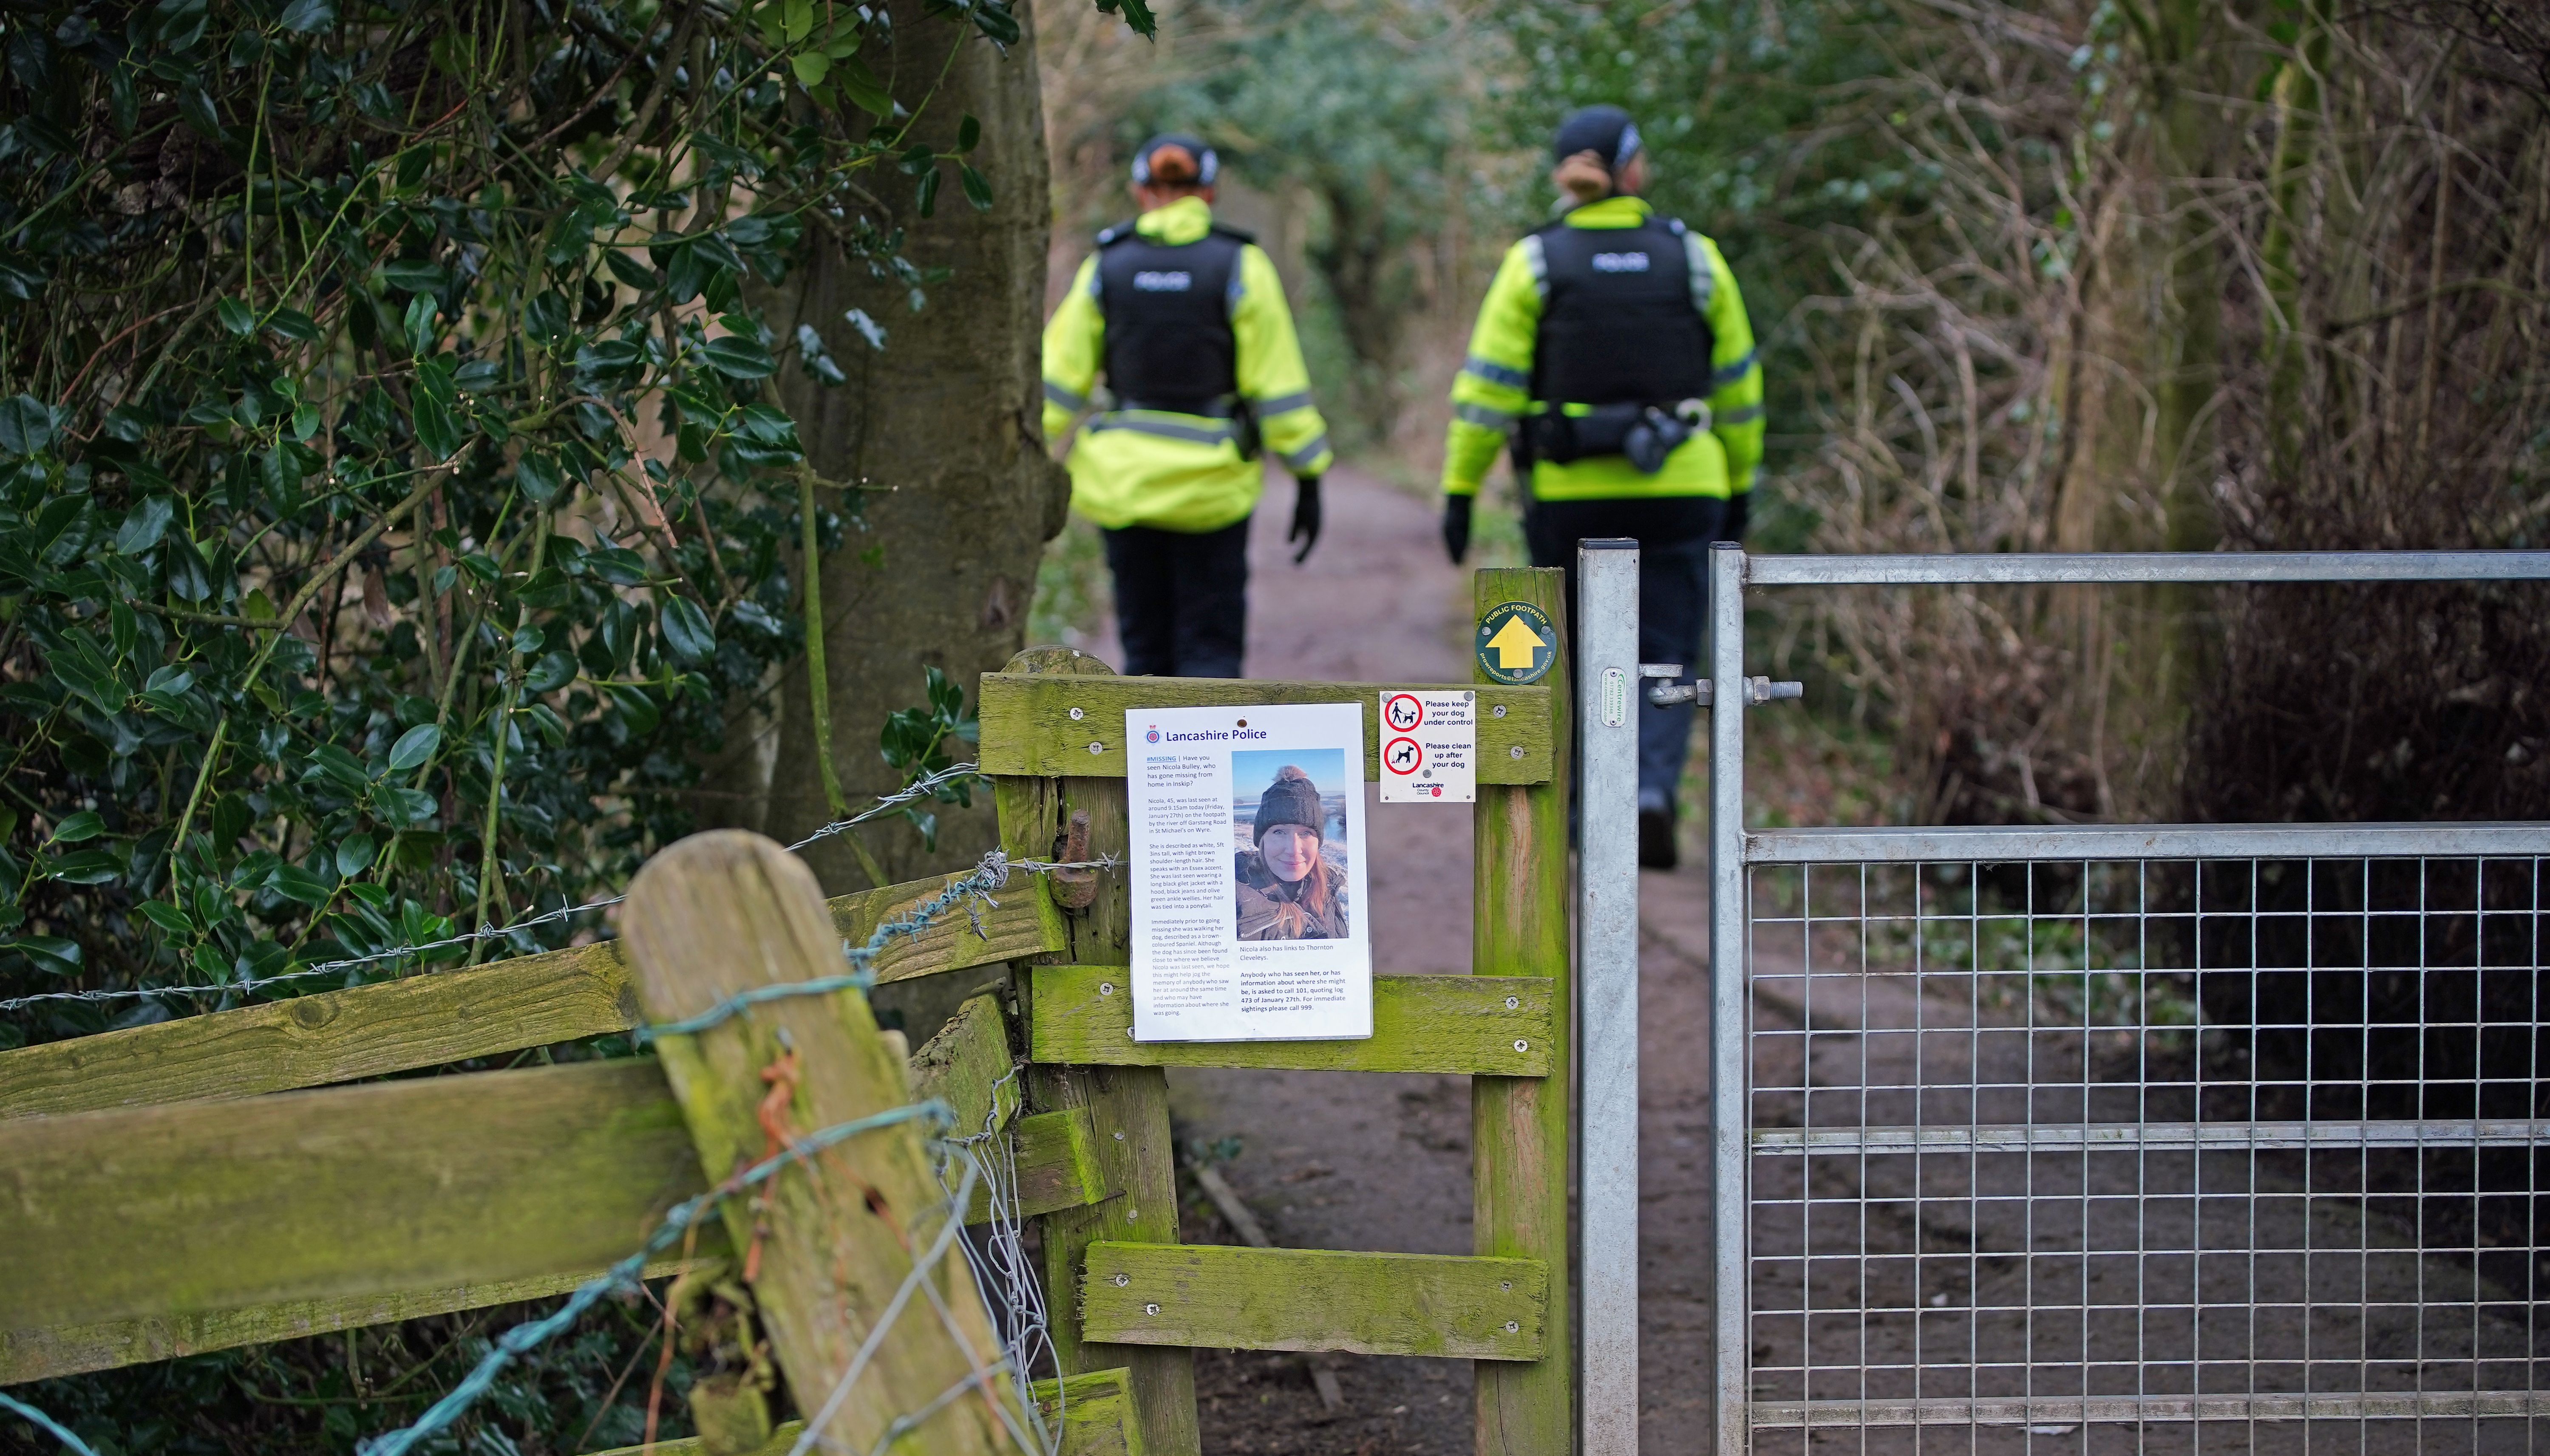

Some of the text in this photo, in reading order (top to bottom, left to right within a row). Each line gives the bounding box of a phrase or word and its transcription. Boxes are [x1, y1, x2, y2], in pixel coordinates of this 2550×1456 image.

[1485, 605, 1547, 625] PUBLIC FOOTPATH
[1167, 729, 1266, 741] Lancashire Police
